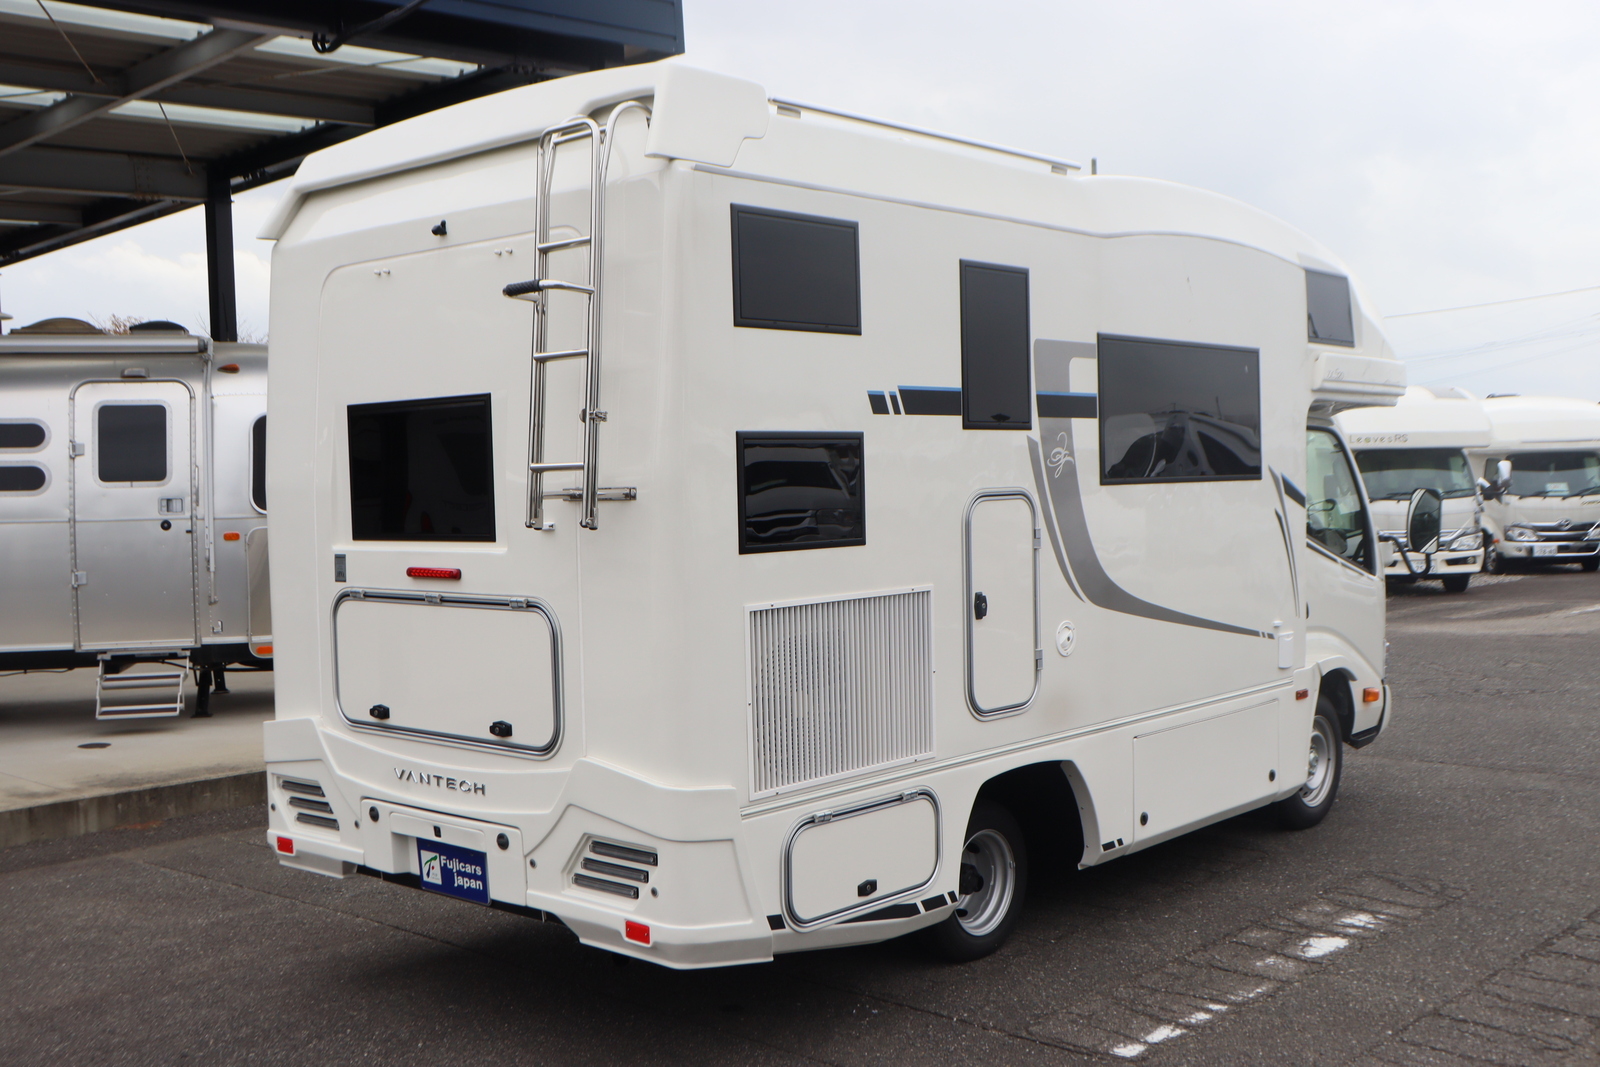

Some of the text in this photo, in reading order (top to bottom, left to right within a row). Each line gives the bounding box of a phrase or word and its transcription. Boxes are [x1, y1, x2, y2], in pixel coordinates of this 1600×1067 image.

[394, 767, 486, 796] VANTECH
[440, 855, 483, 876] Fujicars
[453, 872, 484, 890] japan
